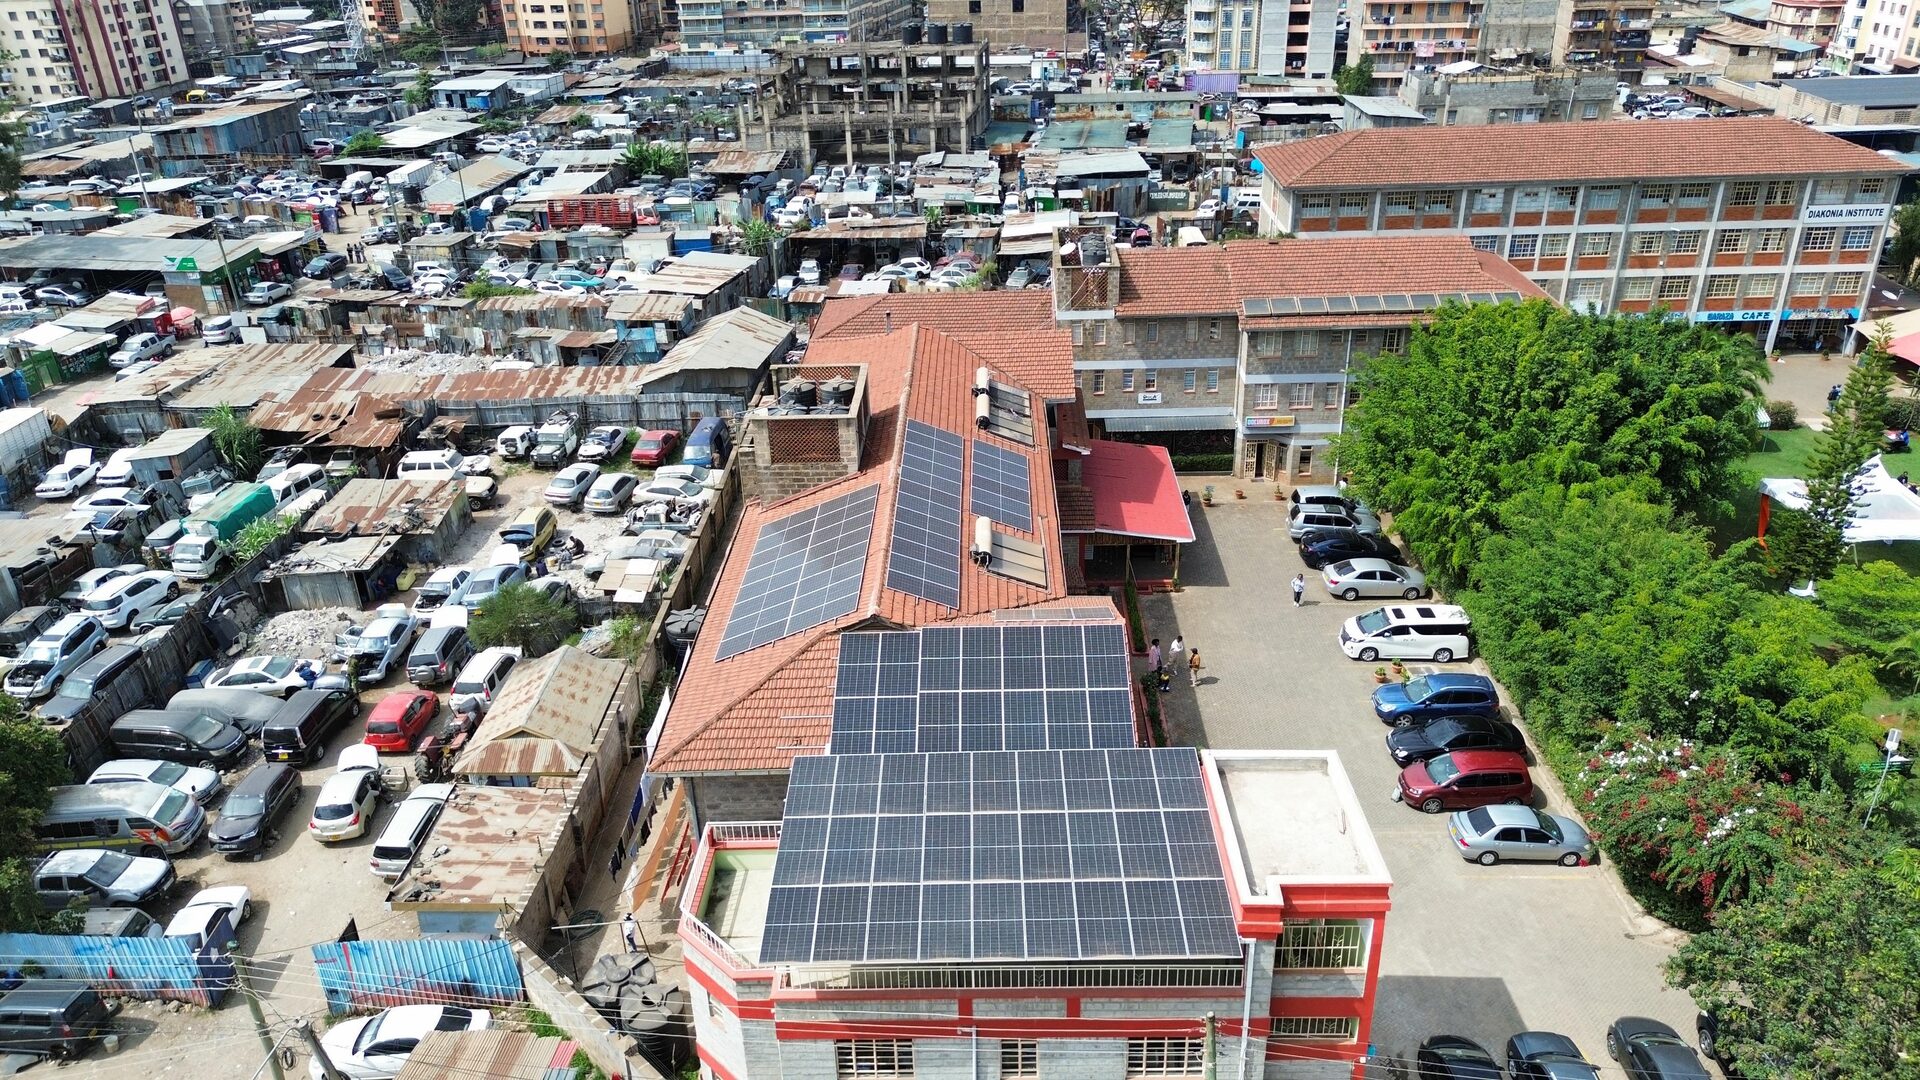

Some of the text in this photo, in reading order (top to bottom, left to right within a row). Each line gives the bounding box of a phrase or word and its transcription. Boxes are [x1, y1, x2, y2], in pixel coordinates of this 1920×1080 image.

[1808, 208, 1884, 218] DIAKONIA INSTITUTE
[1741, 311, 1770, 320] CAFE
